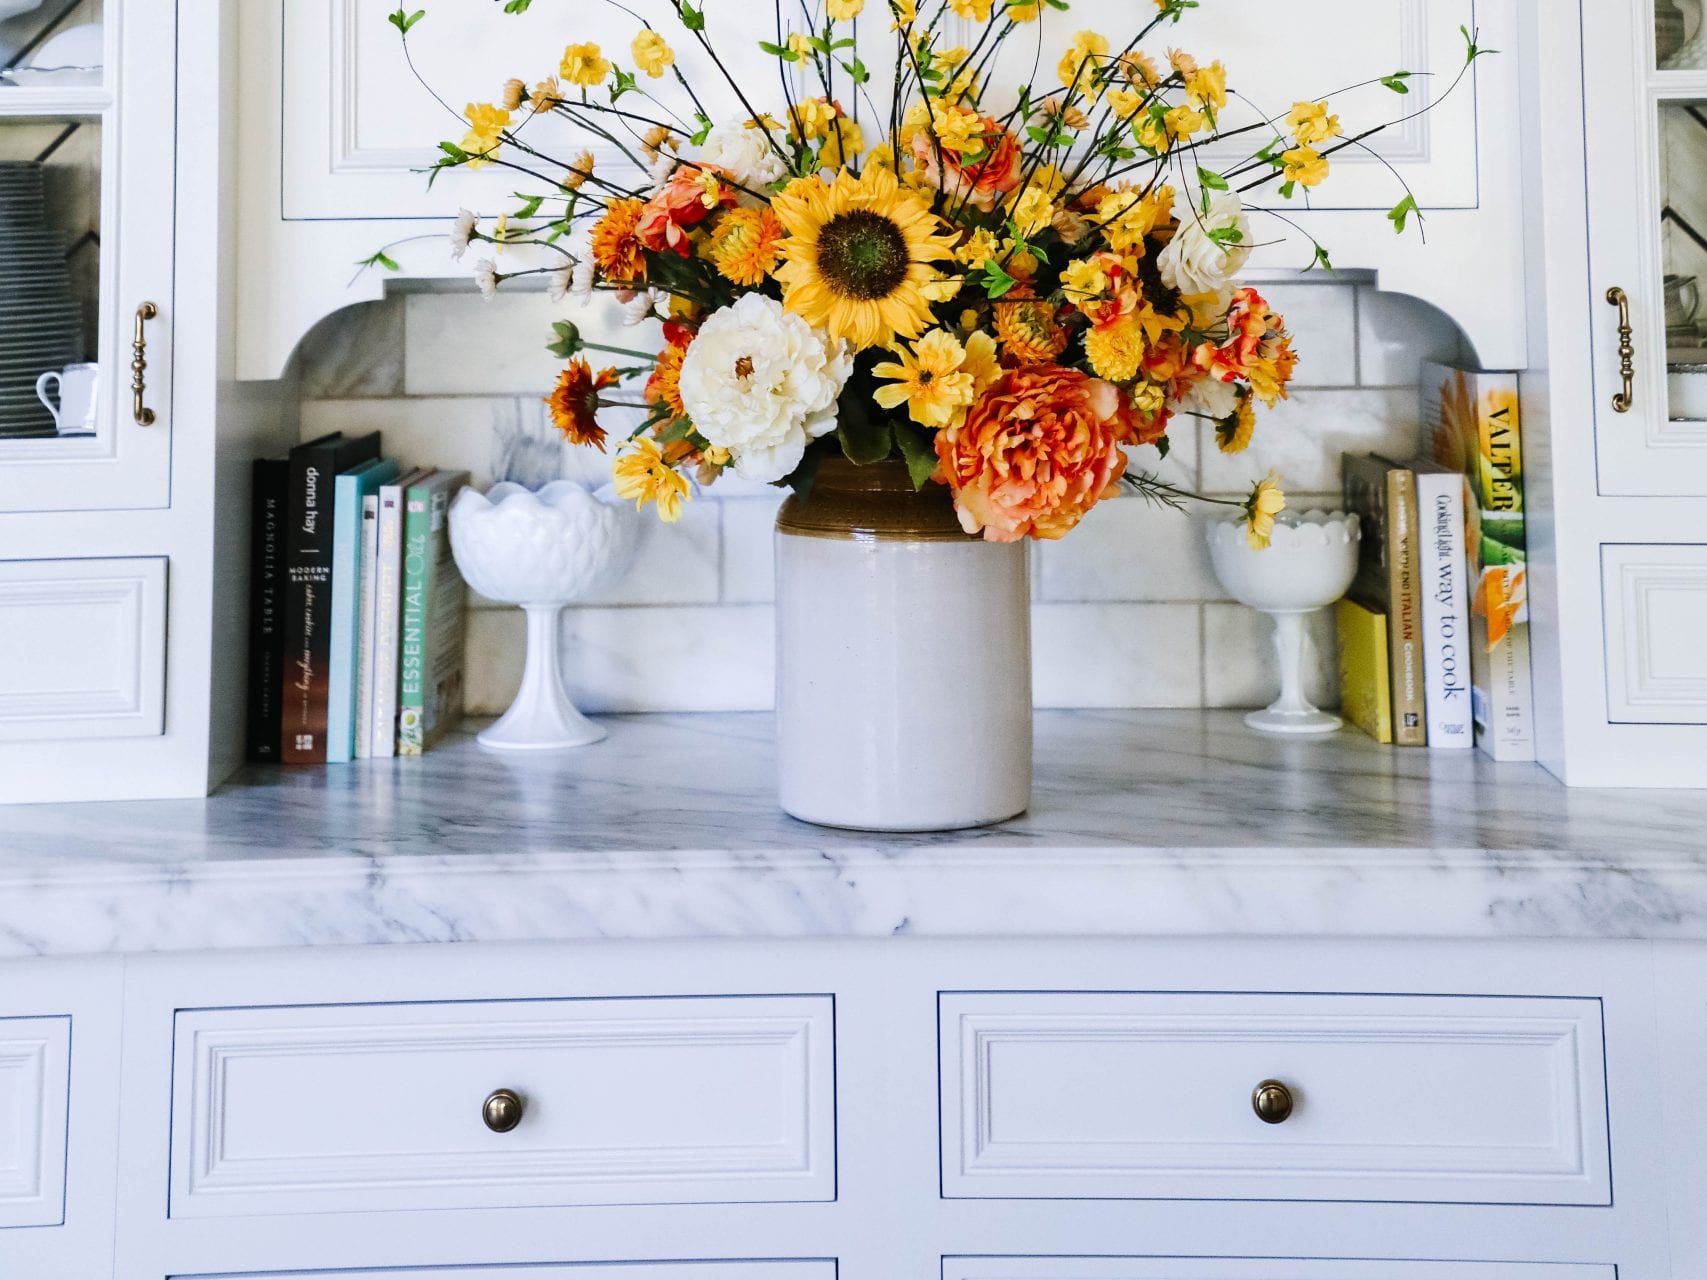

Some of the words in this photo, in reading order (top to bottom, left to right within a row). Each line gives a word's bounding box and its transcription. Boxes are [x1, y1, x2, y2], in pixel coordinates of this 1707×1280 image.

[1489, 407, 1513, 511] VALTER
[306, 466, 320, 508] donna
[302, 510, 318, 534] hay
[1434, 494, 1452, 534] Cooking
[264, 498, 276, 580] MAGNOLIA
[289, 566, 330, 574] MODERN
[1434, 563, 1453, 608] way
[263, 587, 273, 634] TABLE
[1400, 592, 1413, 640] ITALIAN
[1440, 614, 1457, 639] to
[402, 581, 422, 694] ESSENTIAL
[1441, 644, 1466, 703] cook
